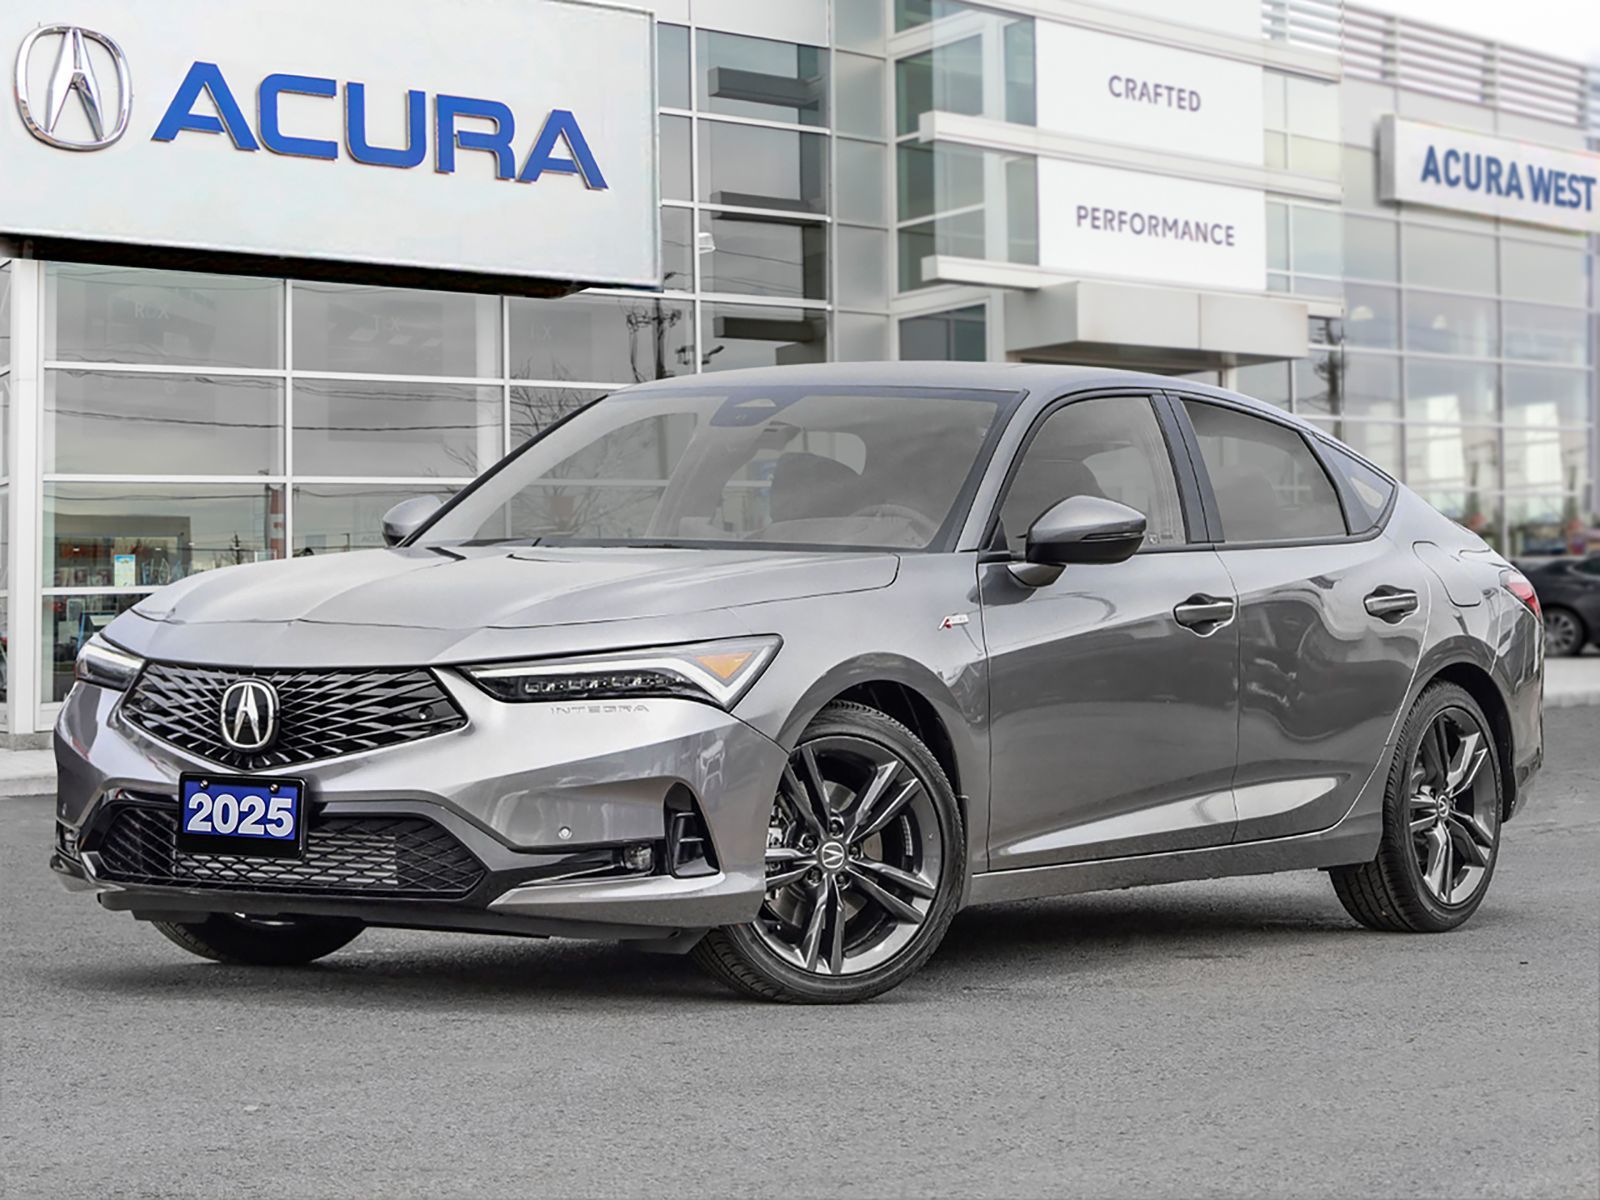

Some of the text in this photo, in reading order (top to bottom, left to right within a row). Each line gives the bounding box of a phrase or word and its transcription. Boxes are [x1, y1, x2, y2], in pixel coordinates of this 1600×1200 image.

[1108, 74, 1202, 113] CRAFTED
[151, 61, 609, 191] ACURA
[1420, 144, 1597, 212] ACURA WEST
[1075, 205, 1236, 247] PERFORMANCE
[187, 792, 294, 837] 2025
